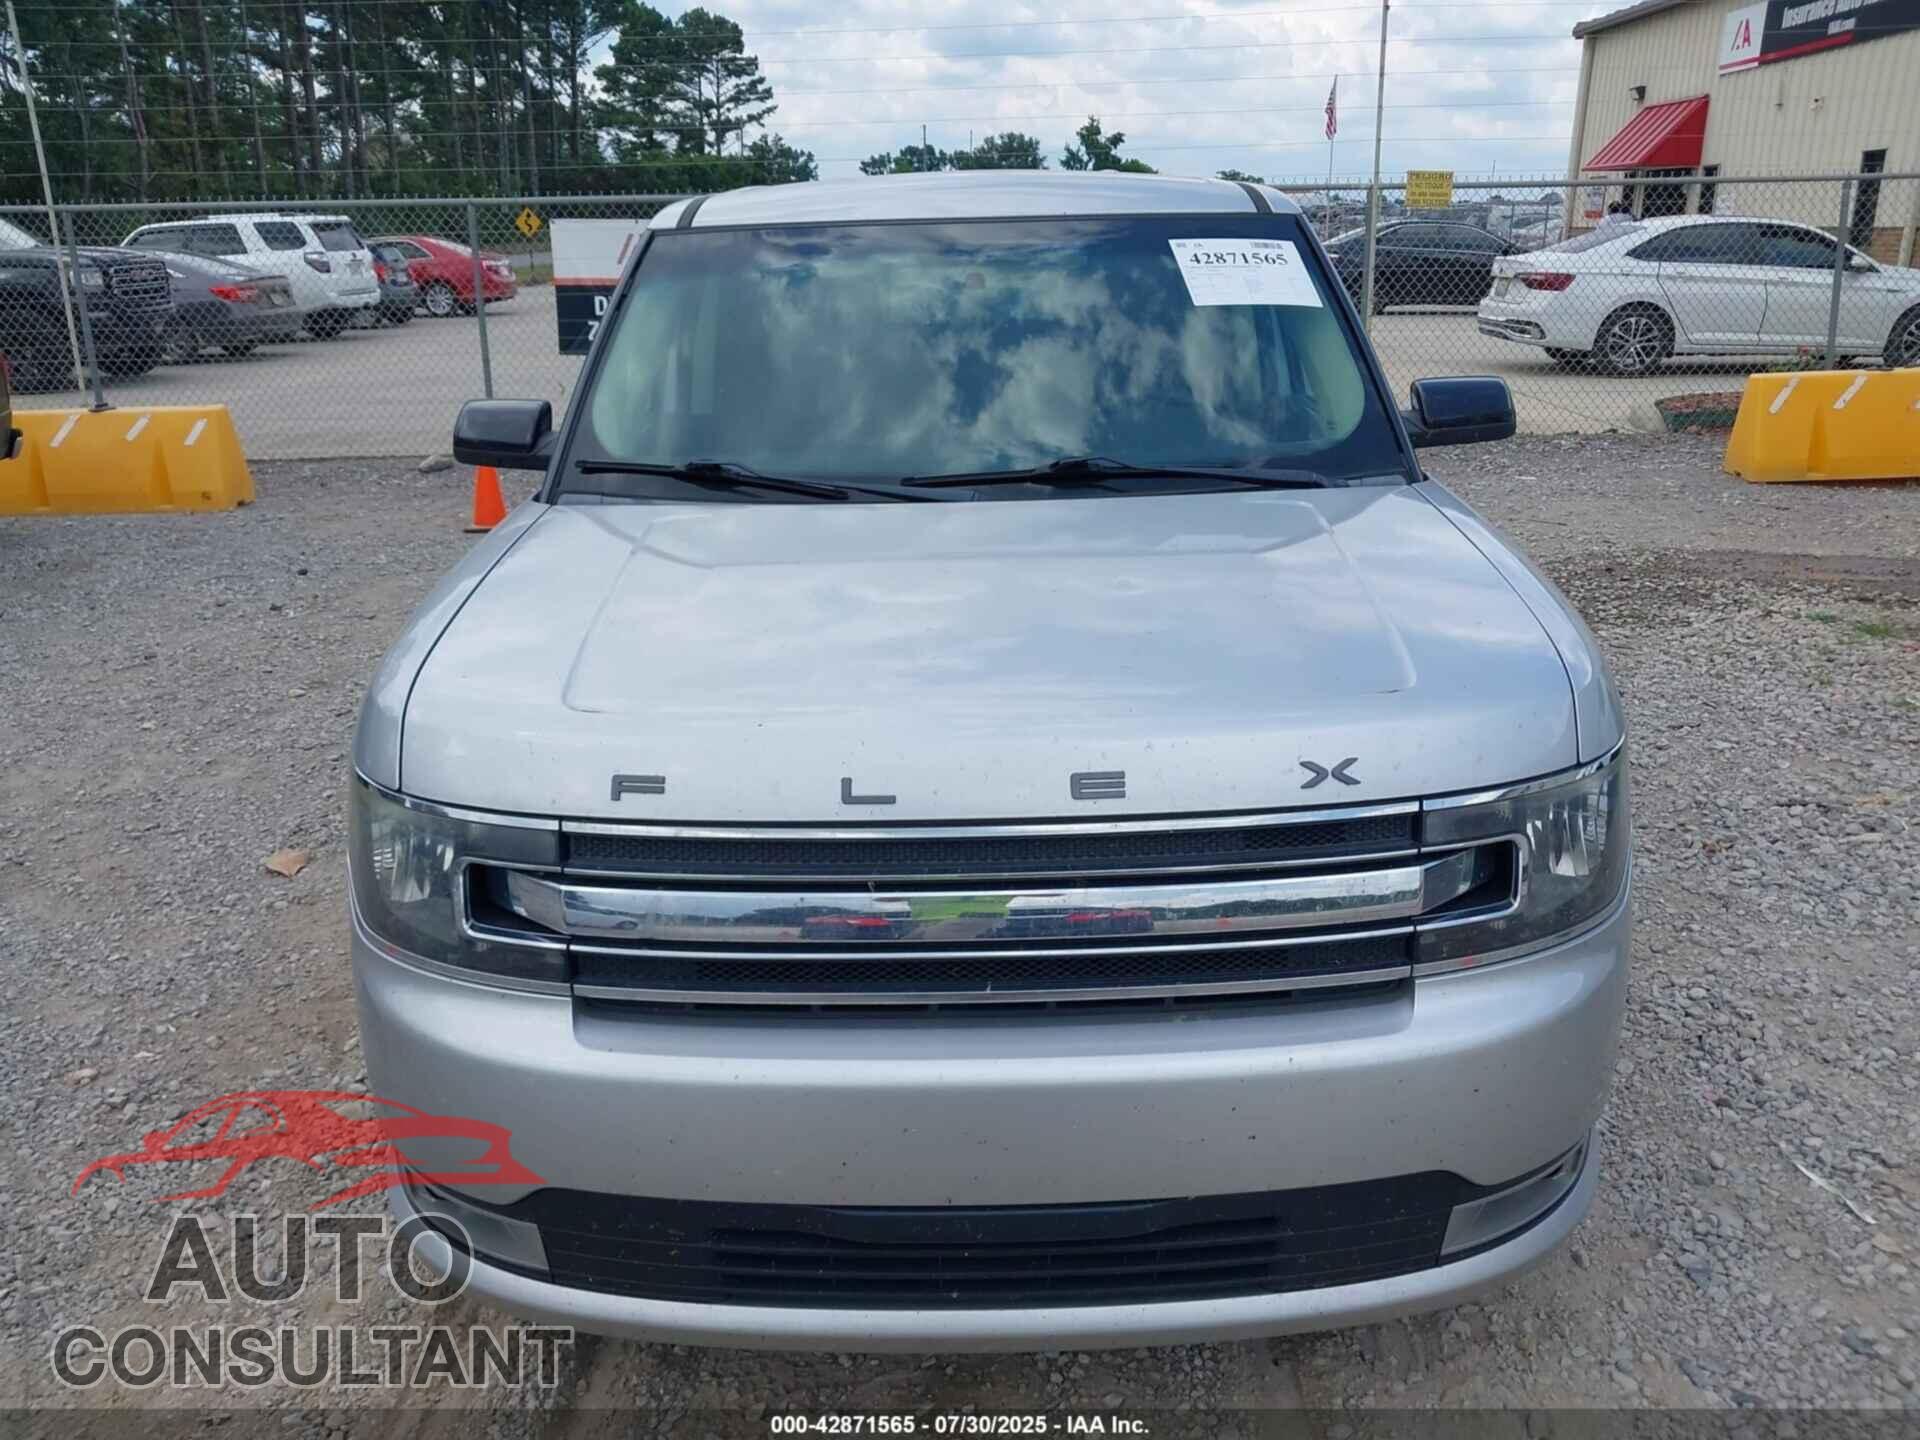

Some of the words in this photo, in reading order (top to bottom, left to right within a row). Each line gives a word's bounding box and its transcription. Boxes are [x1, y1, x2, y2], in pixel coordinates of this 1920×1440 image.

[1781, 0, 1835, 29] Insurance
[1189, 251, 1289, 266] 42871565
[610, 757, 1361, 805] FLEX
